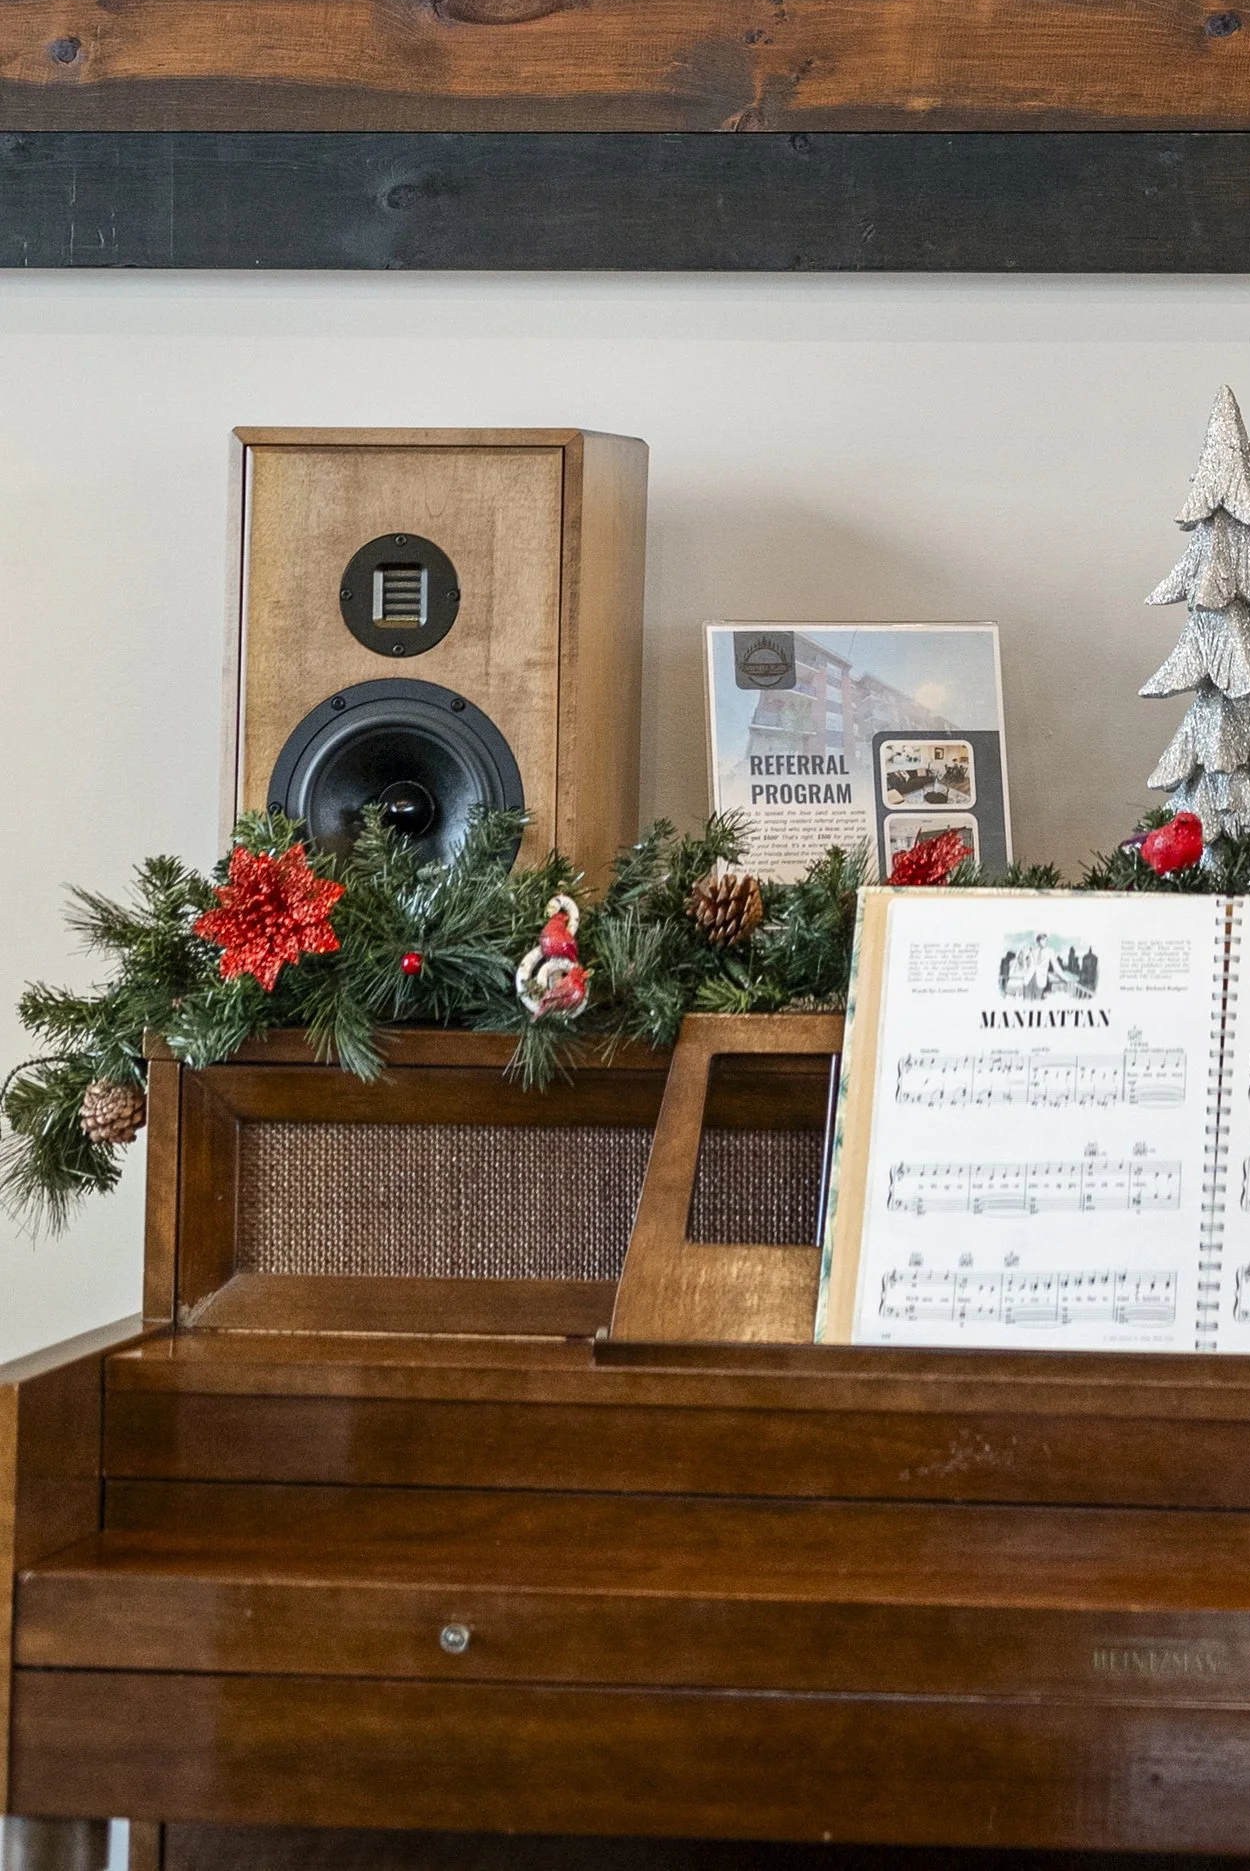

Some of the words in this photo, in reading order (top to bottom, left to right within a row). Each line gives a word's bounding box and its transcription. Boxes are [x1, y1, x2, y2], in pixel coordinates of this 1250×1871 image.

[749, 754, 850, 776] REFERRAL
[751, 783, 853, 805] PROGRAM
[979, 1009, 1111, 1029] MANHATTAN
